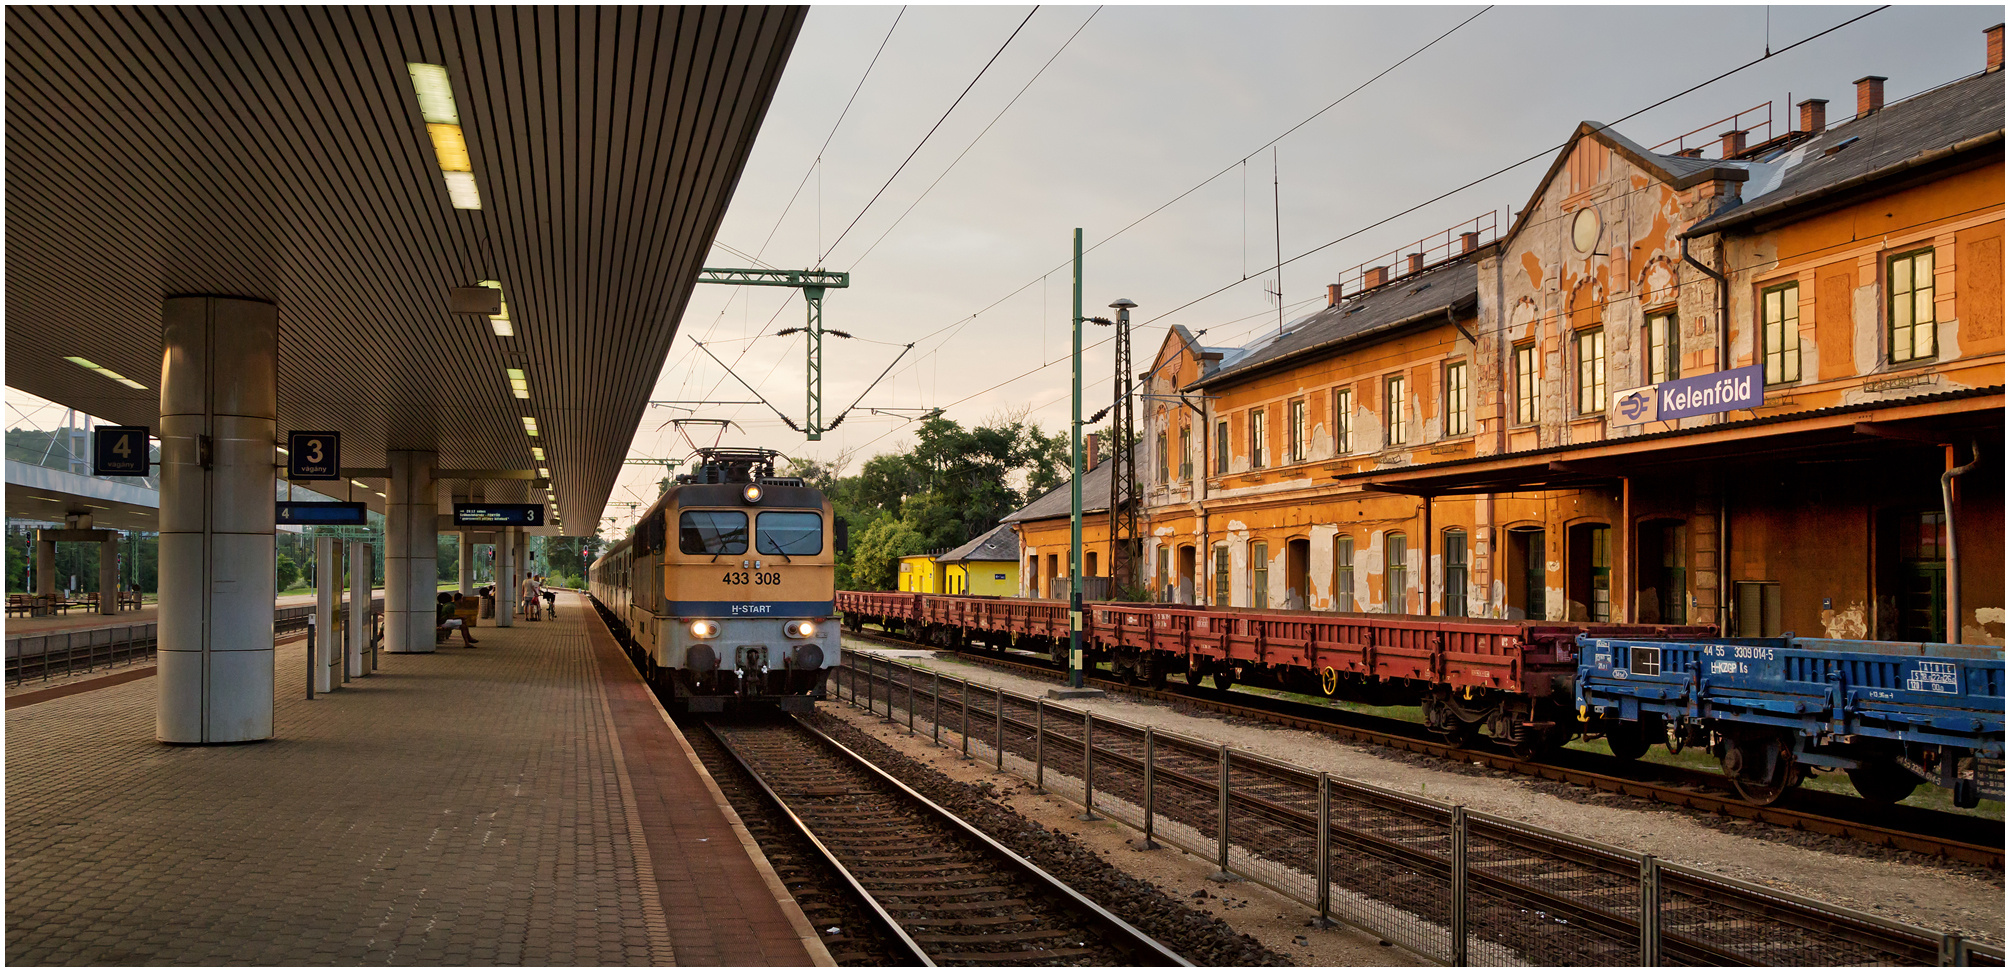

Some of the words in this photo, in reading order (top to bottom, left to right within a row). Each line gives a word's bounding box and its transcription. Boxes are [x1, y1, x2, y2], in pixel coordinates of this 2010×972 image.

[1663, 375, 1751, 412] Kelenföld
[112, 434, 131, 458] 4
[306, 439, 323, 463] 3
[281, 507, 289, 519] 4
[527, 509, 535, 521] 3
[722, 572, 749, 585] 433
[754, 572, 781, 585] 308
[731, 605, 771, 614] H-START
[1703, 645, 1713, 656] 44
[1715, 645, 1725, 657] 55
[1734, 647, 1752, 659] 3309
[1753, 648, 1774, 661] 014-5
